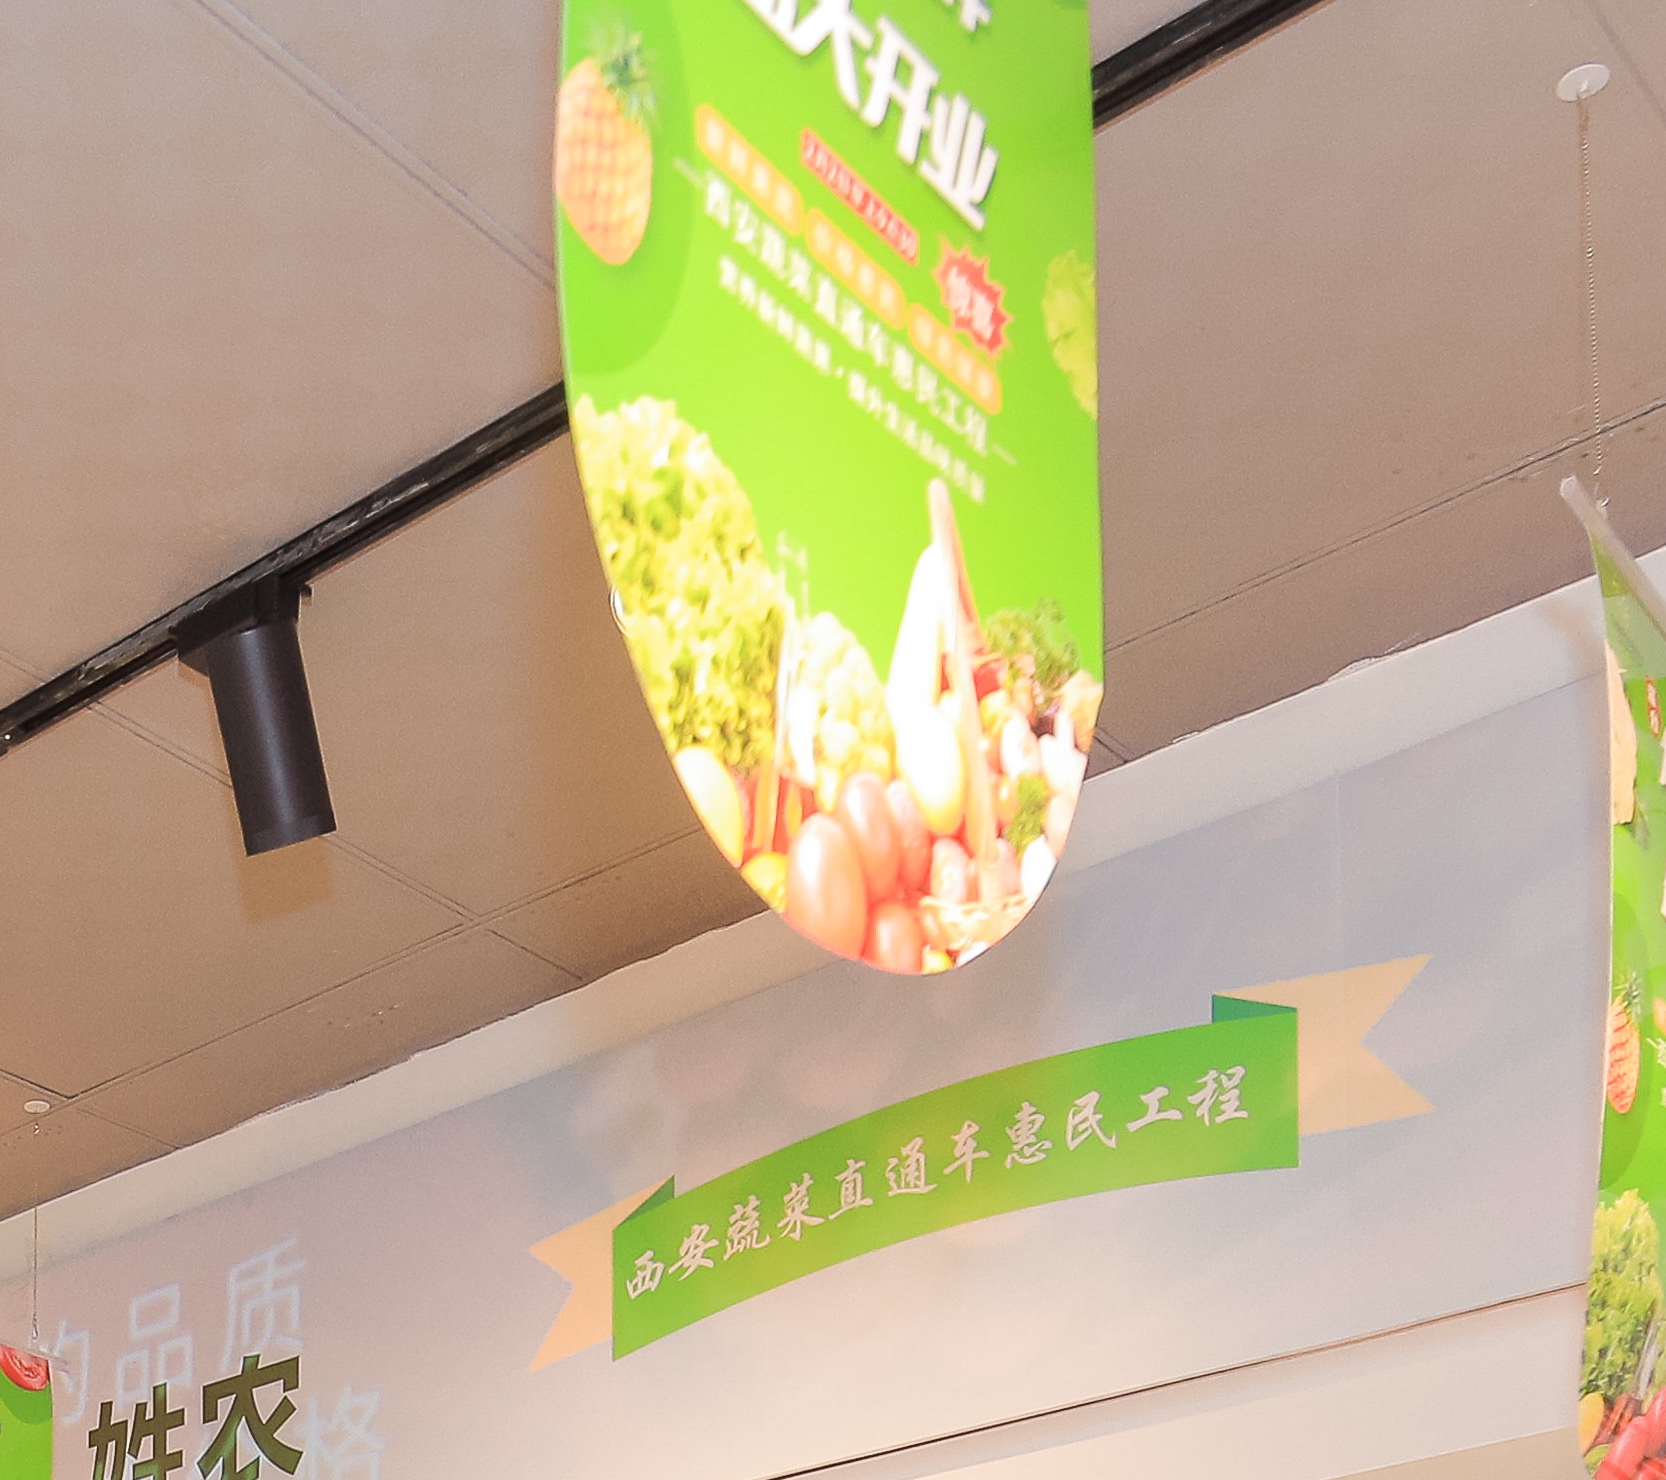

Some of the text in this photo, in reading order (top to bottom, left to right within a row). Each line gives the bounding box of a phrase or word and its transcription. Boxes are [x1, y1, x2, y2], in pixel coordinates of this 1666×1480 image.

[625, 1063, 1250, 1301] 西安蔬菜直通车惠民工程
